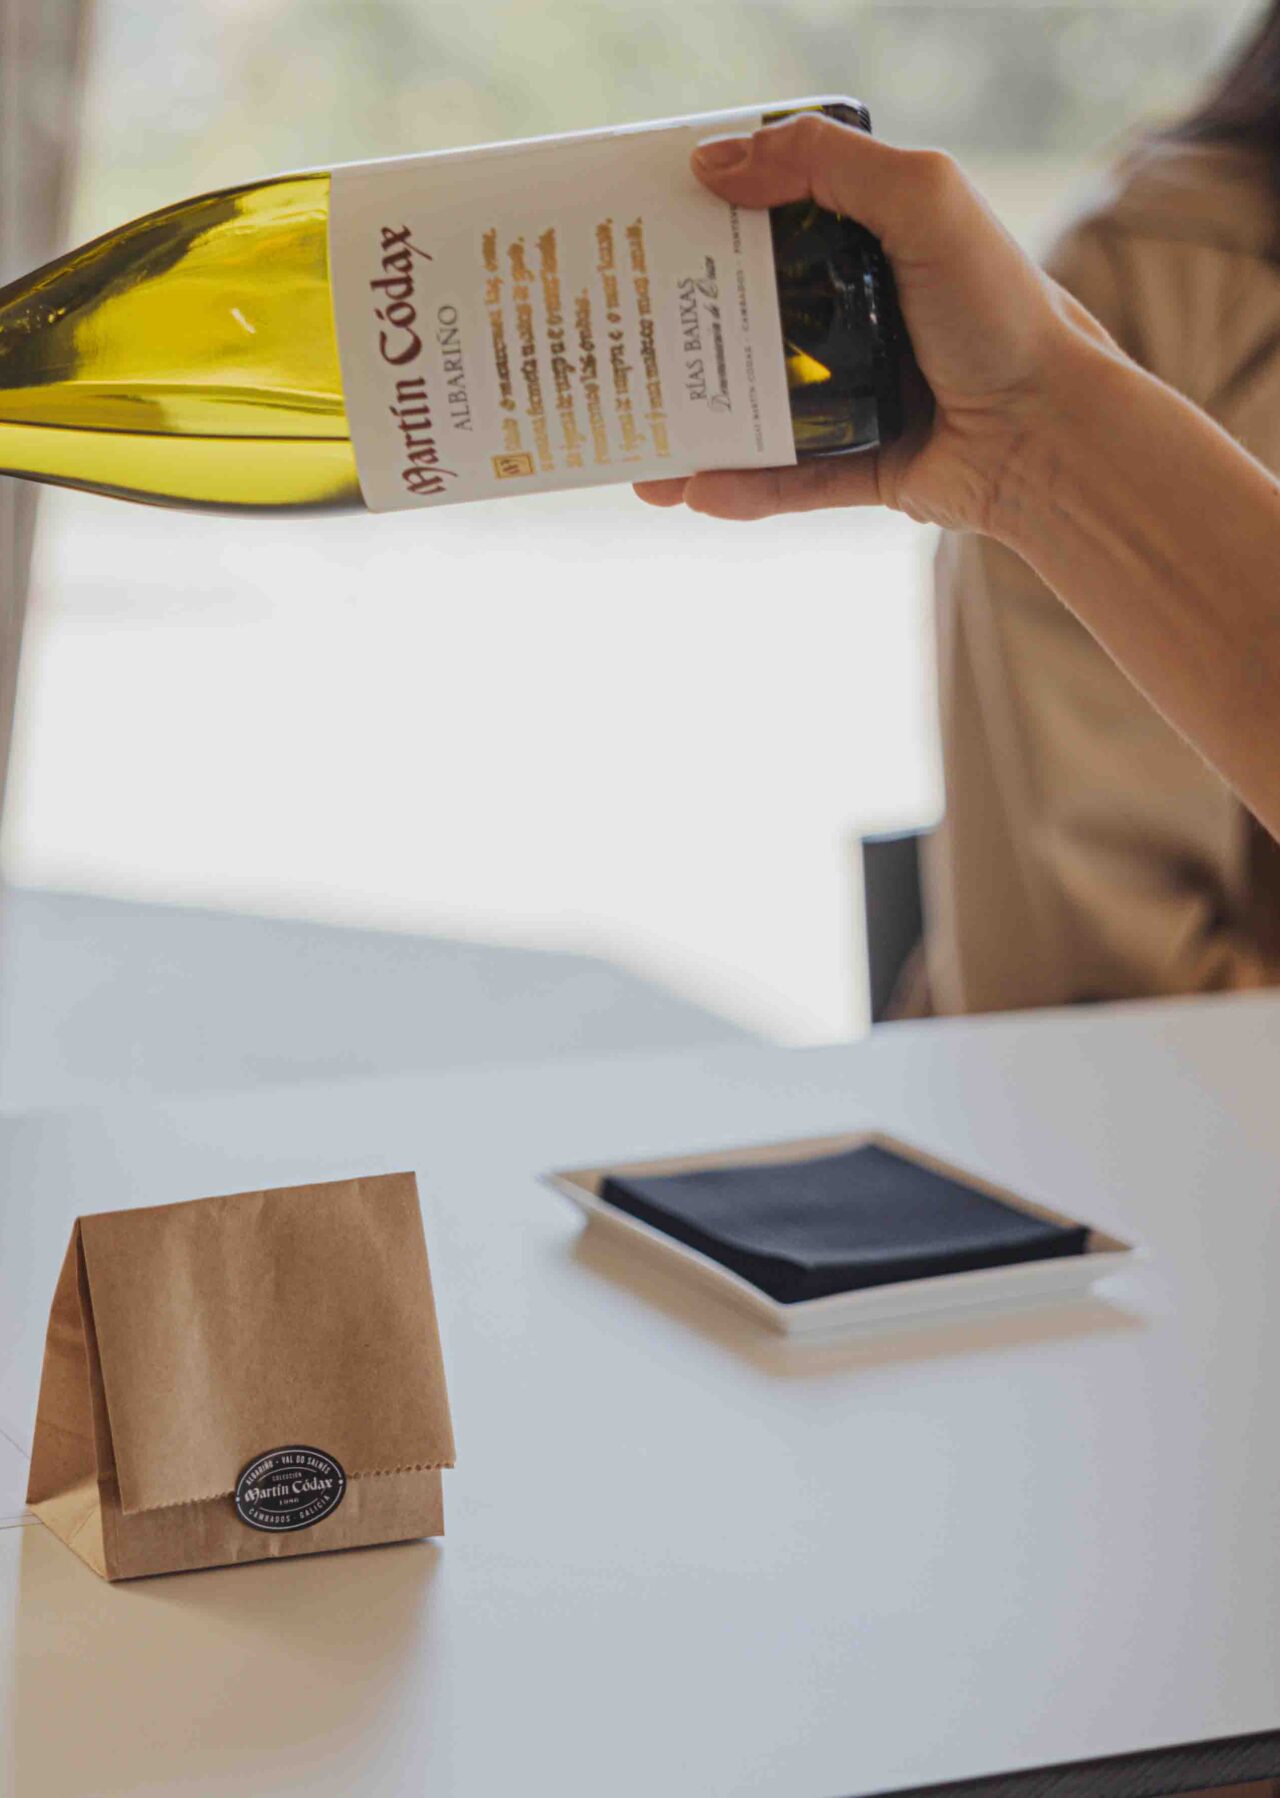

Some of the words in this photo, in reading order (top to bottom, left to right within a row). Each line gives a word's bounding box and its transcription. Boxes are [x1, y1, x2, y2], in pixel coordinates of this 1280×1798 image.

[369, 224, 433, 366] Códax
[677, 277, 702, 352] BAIXAS
[436, 304, 473, 432] ALBARIÑO
[683, 358, 707, 401] RÍAS
[390, 378, 457, 495] Martín
[282, 1455, 293, 1464] VAL
[296, 1455, 305, 1464] DO
[244, 1483, 289, 1506] Martín
[291, 1476, 334, 1495] Códax
[248, 1507, 291, 1524] CAMBADOS
[299, 1494, 331, 1519] GALICIA
